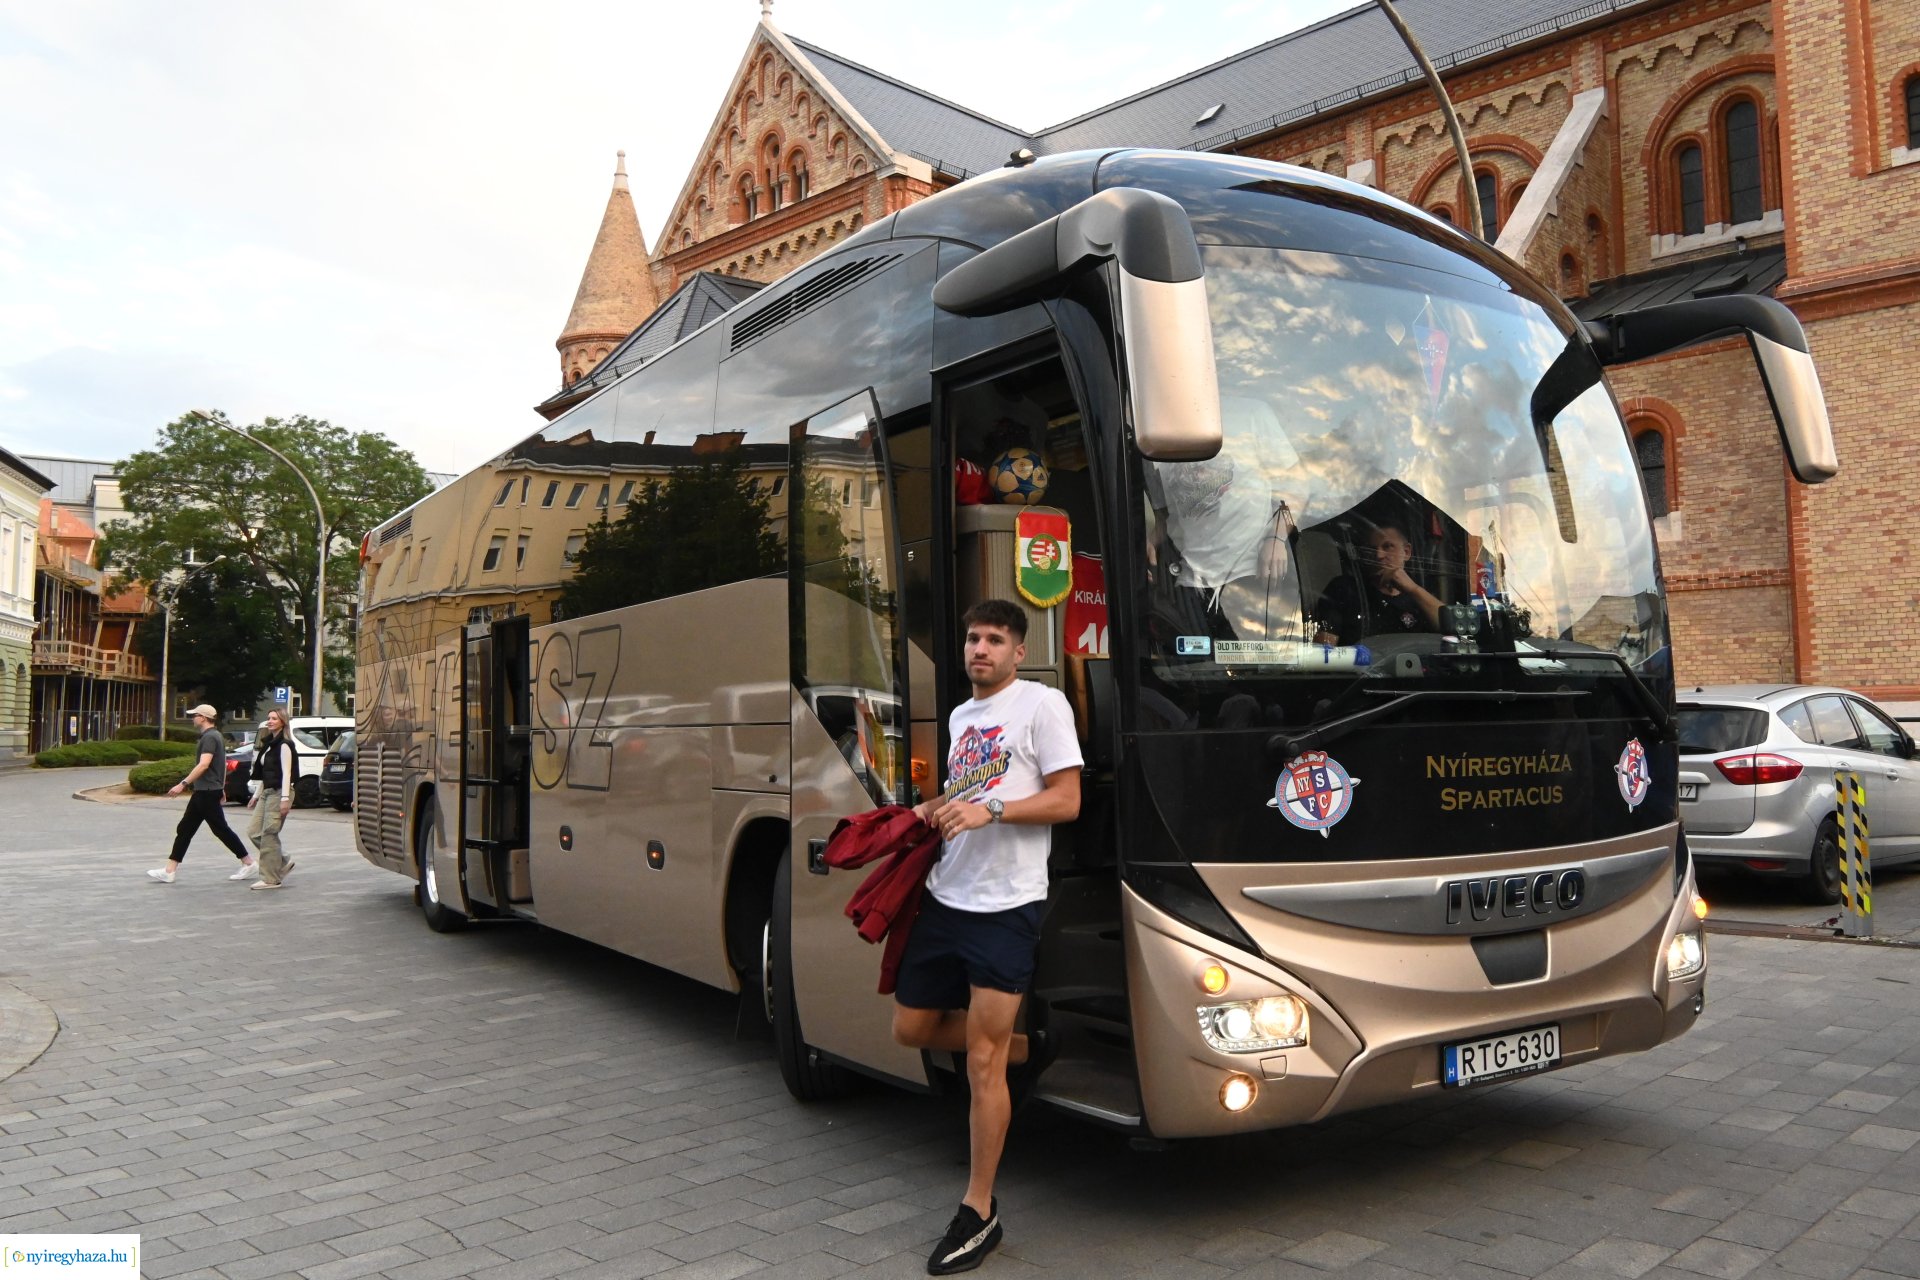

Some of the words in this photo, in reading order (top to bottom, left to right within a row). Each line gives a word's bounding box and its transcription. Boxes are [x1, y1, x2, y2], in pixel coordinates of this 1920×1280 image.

[1217, 642, 1230, 651] OLD
[1231, 642, 1264, 651] TRAFFORD
[276, 687, 286, 699] P
[1426, 750, 1573, 779] NYÍREGYHÁZA
[1296, 776, 1310, 793] NY
[1315, 772, 1326, 788] S
[1307, 797, 1316, 812] F
[1319, 794, 1329, 809] C
[1440, 786, 1564, 811] SPARTACUS
[1446, 869, 1585, 925] IVECO
[1448, 1067, 1455, 1078] H
[1462, 1030, 1555, 1076] RTG-630
